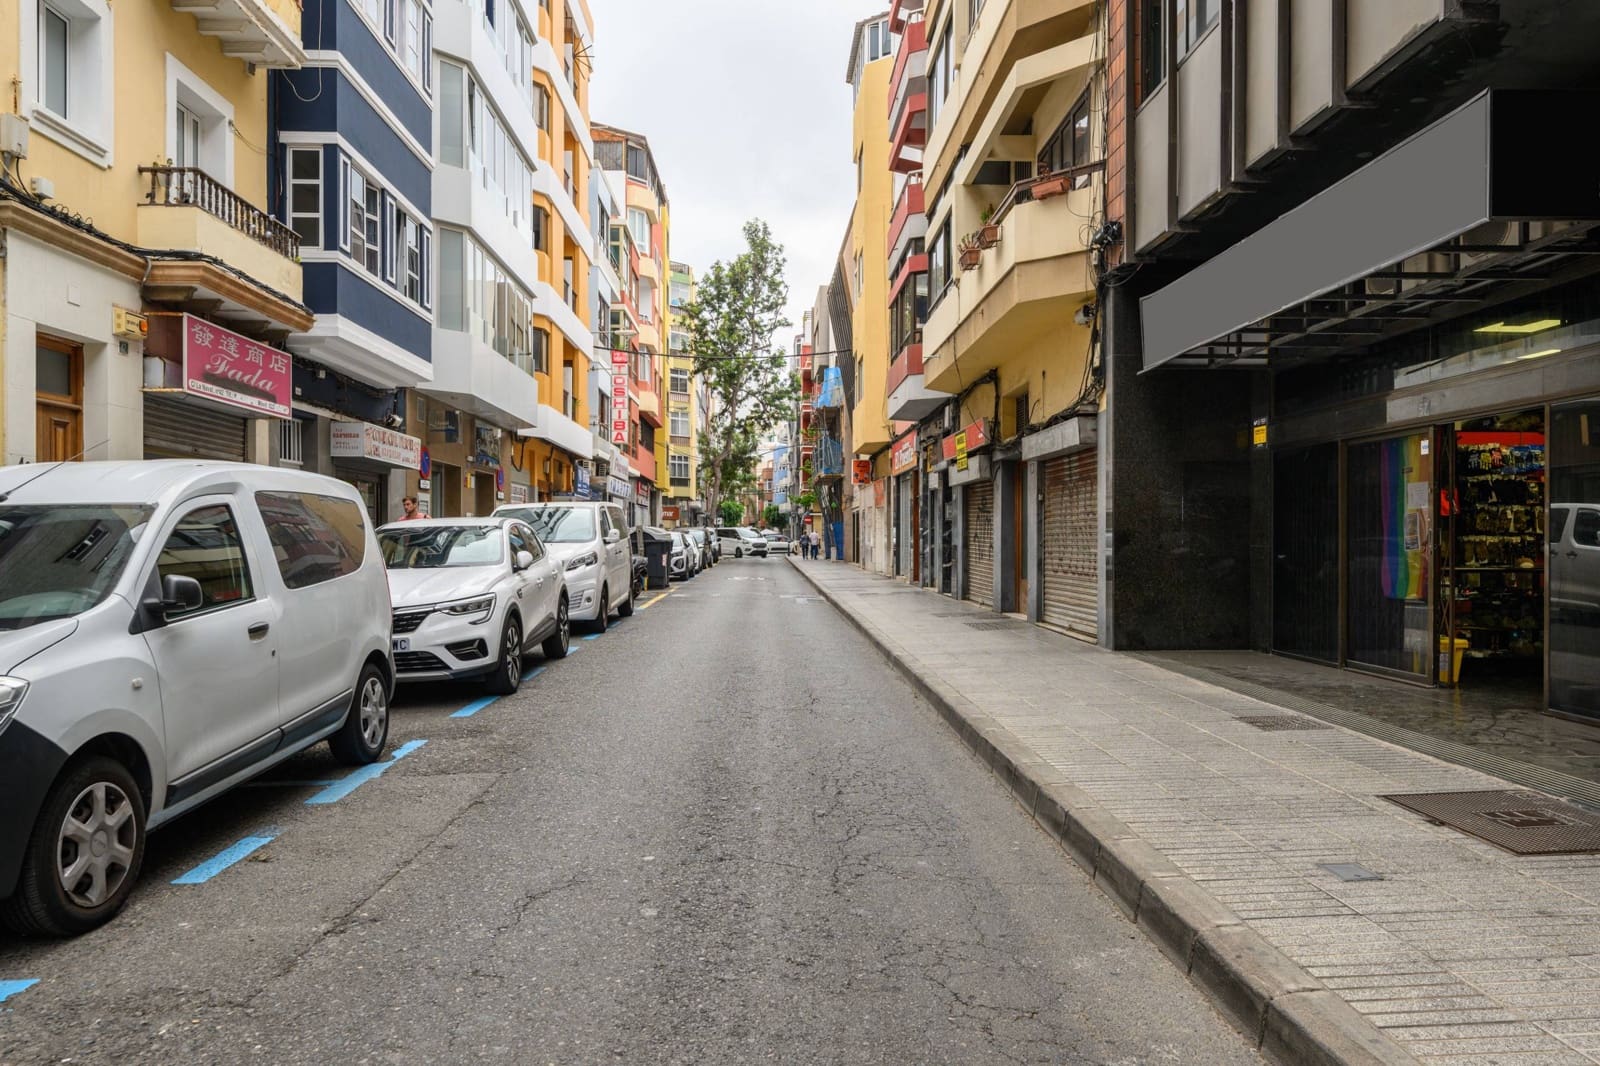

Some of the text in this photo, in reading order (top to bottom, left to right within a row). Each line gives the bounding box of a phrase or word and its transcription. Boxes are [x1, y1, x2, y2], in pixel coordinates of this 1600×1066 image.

[191, 323, 288, 374] 發達商店
[613, 365, 626, 442] TOSHIBA
